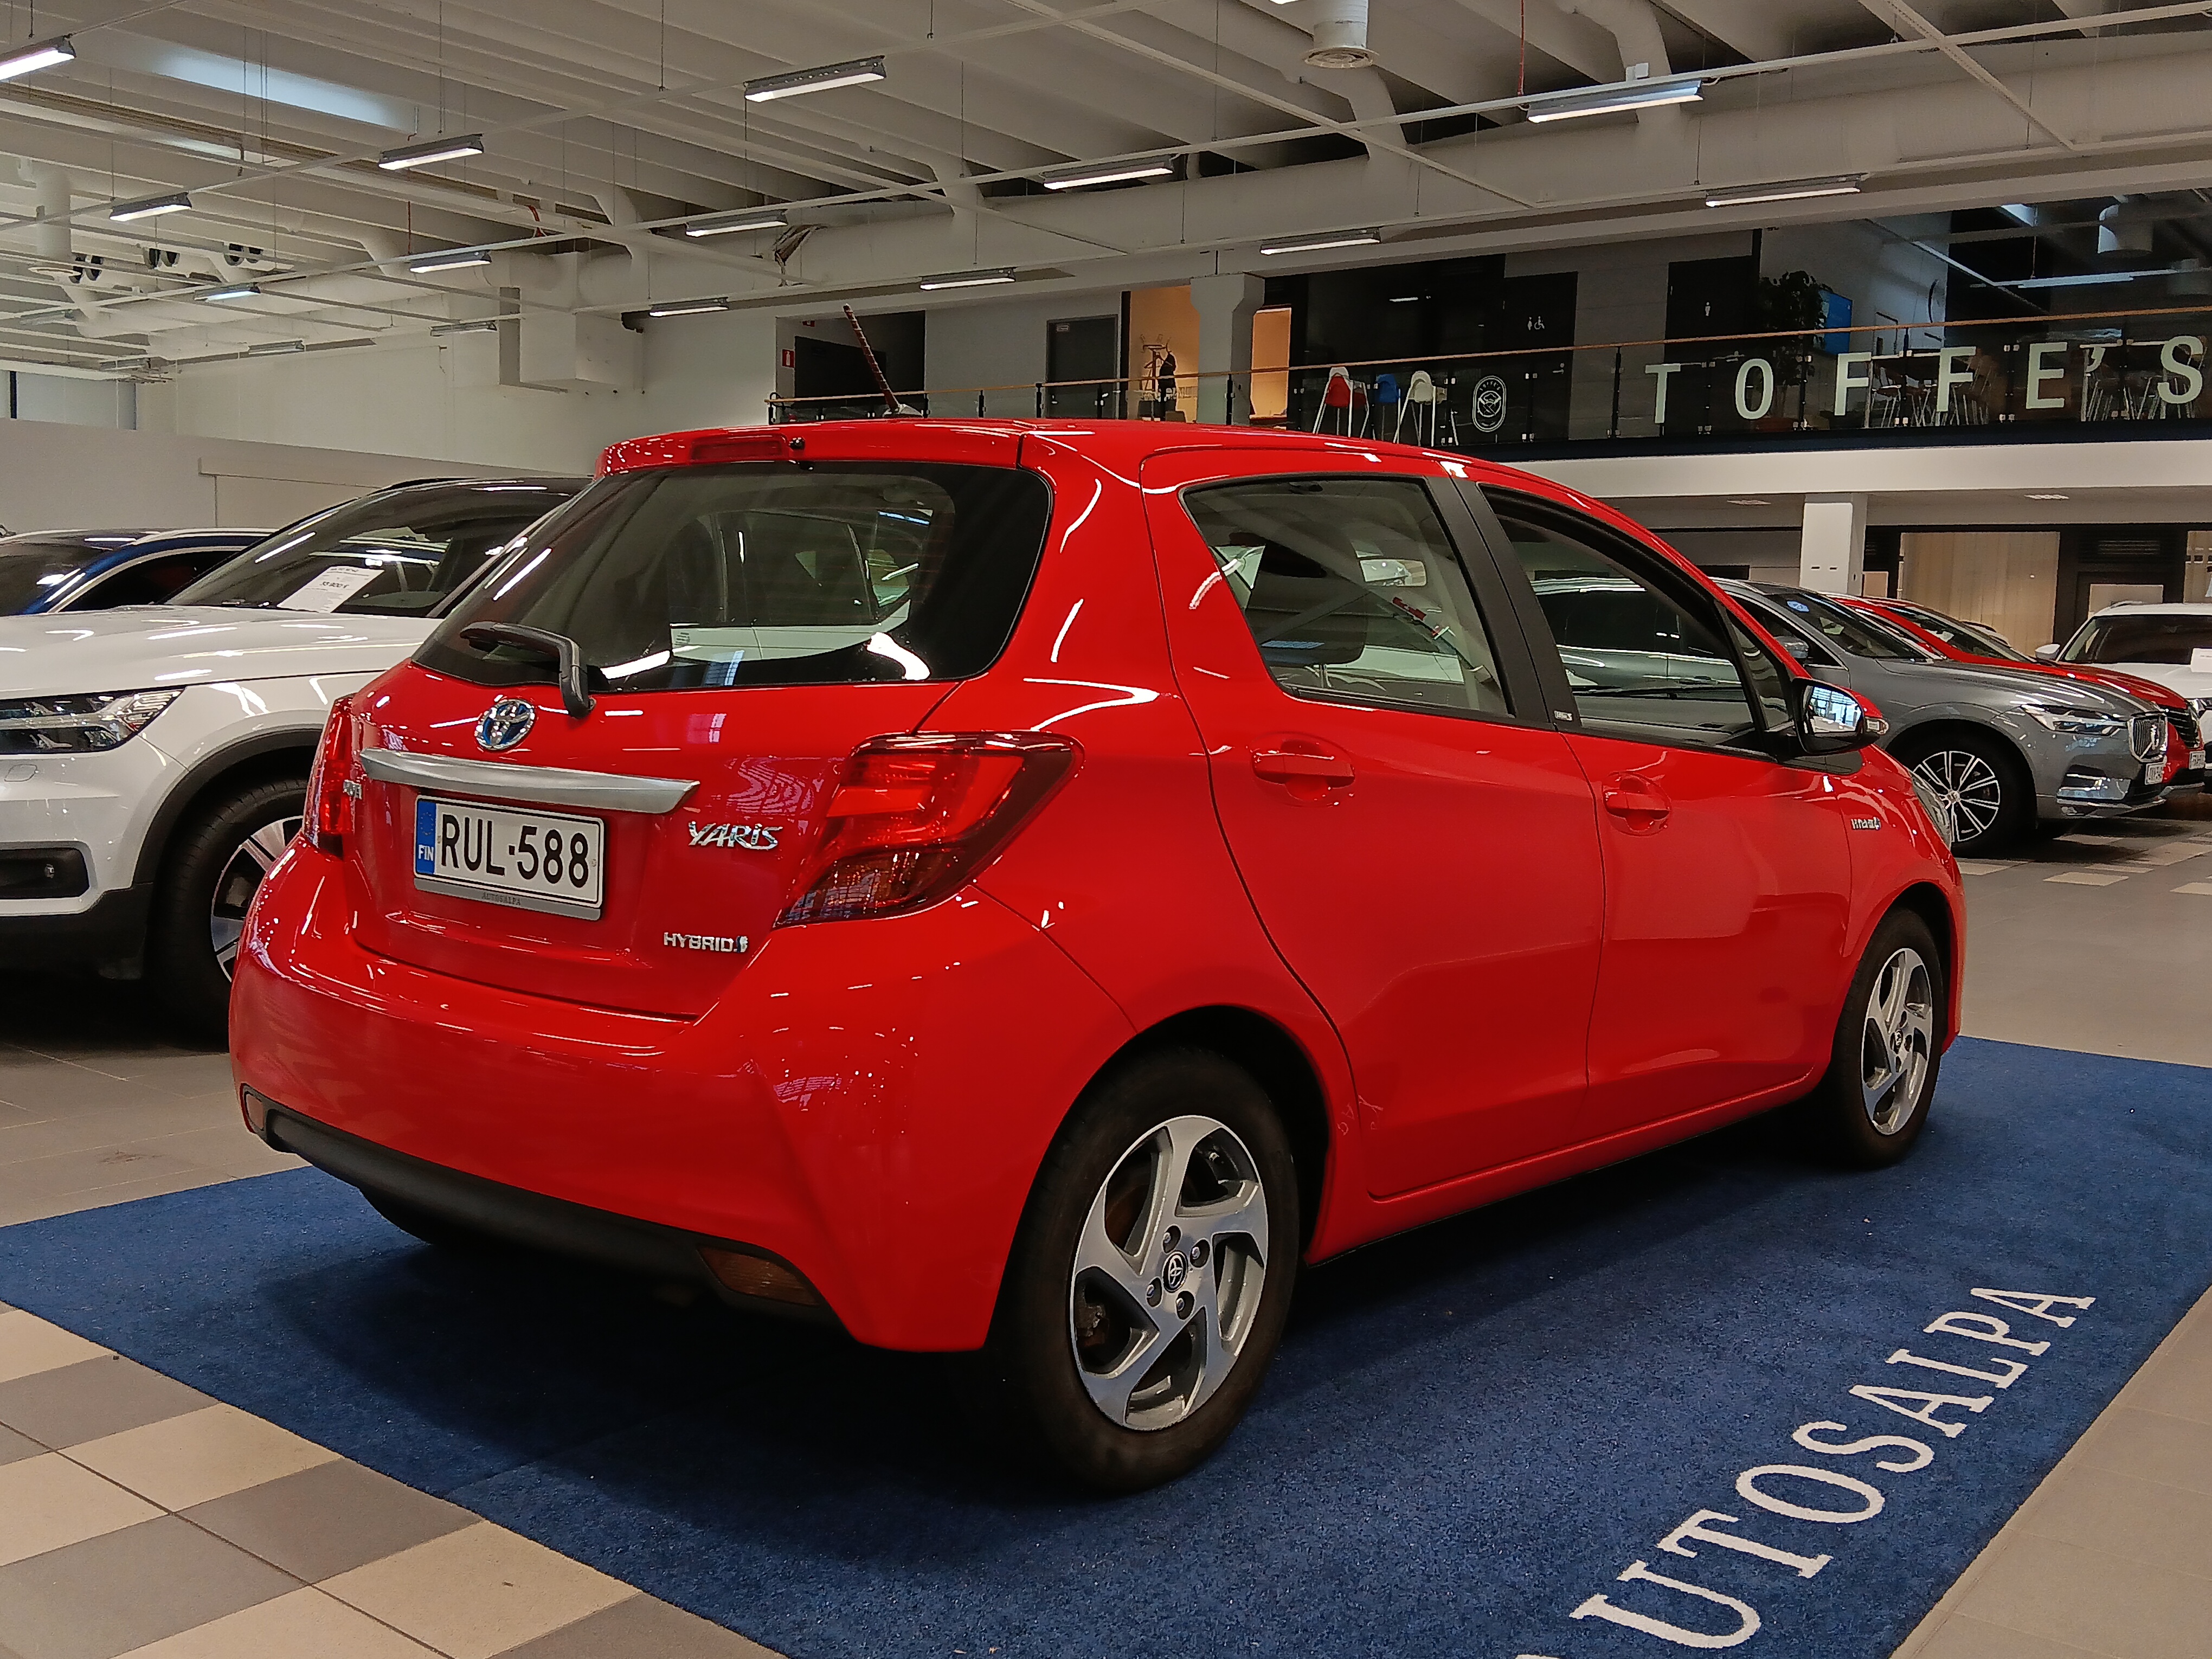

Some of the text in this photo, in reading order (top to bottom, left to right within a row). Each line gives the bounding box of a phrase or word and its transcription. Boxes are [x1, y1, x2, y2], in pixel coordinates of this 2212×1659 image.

[1645, 335, 2203, 424] TOFFE'S
[418, 844, 434, 861] FIN
[441, 814, 589, 888] RUL-588
[663, 931, 734, 953] HYBRID
[1515, 1287, 2095, 1659] UTOSALPA
